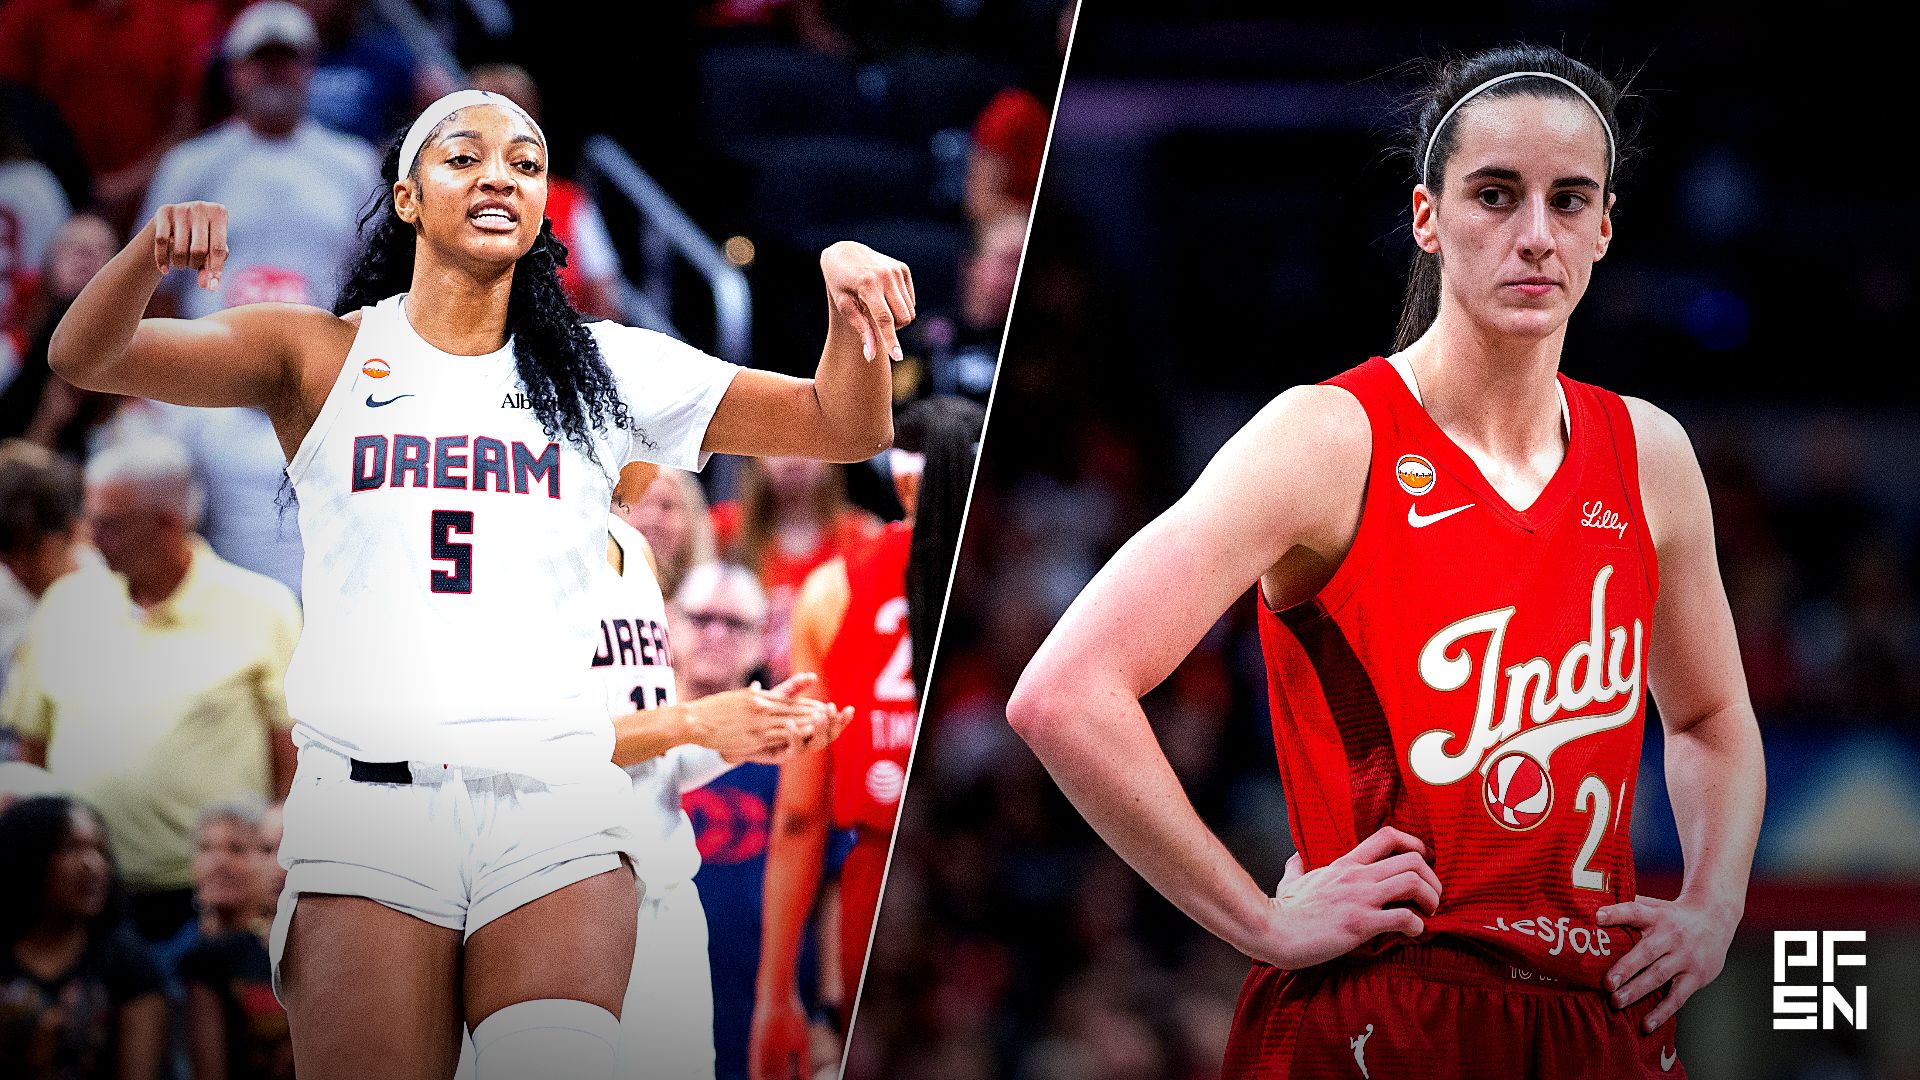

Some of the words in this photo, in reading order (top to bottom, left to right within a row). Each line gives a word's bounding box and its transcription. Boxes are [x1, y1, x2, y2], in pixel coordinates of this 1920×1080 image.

[351, 434, 561, 500] DREAM
[430, 509, 475, 595] 5
[1581, 500, 1629, 540] Lilly
[590, 618, 672, 669] DREA
[1408, 565, 1643, 786] Indy
[1571, 772, 1628, 893] 2
